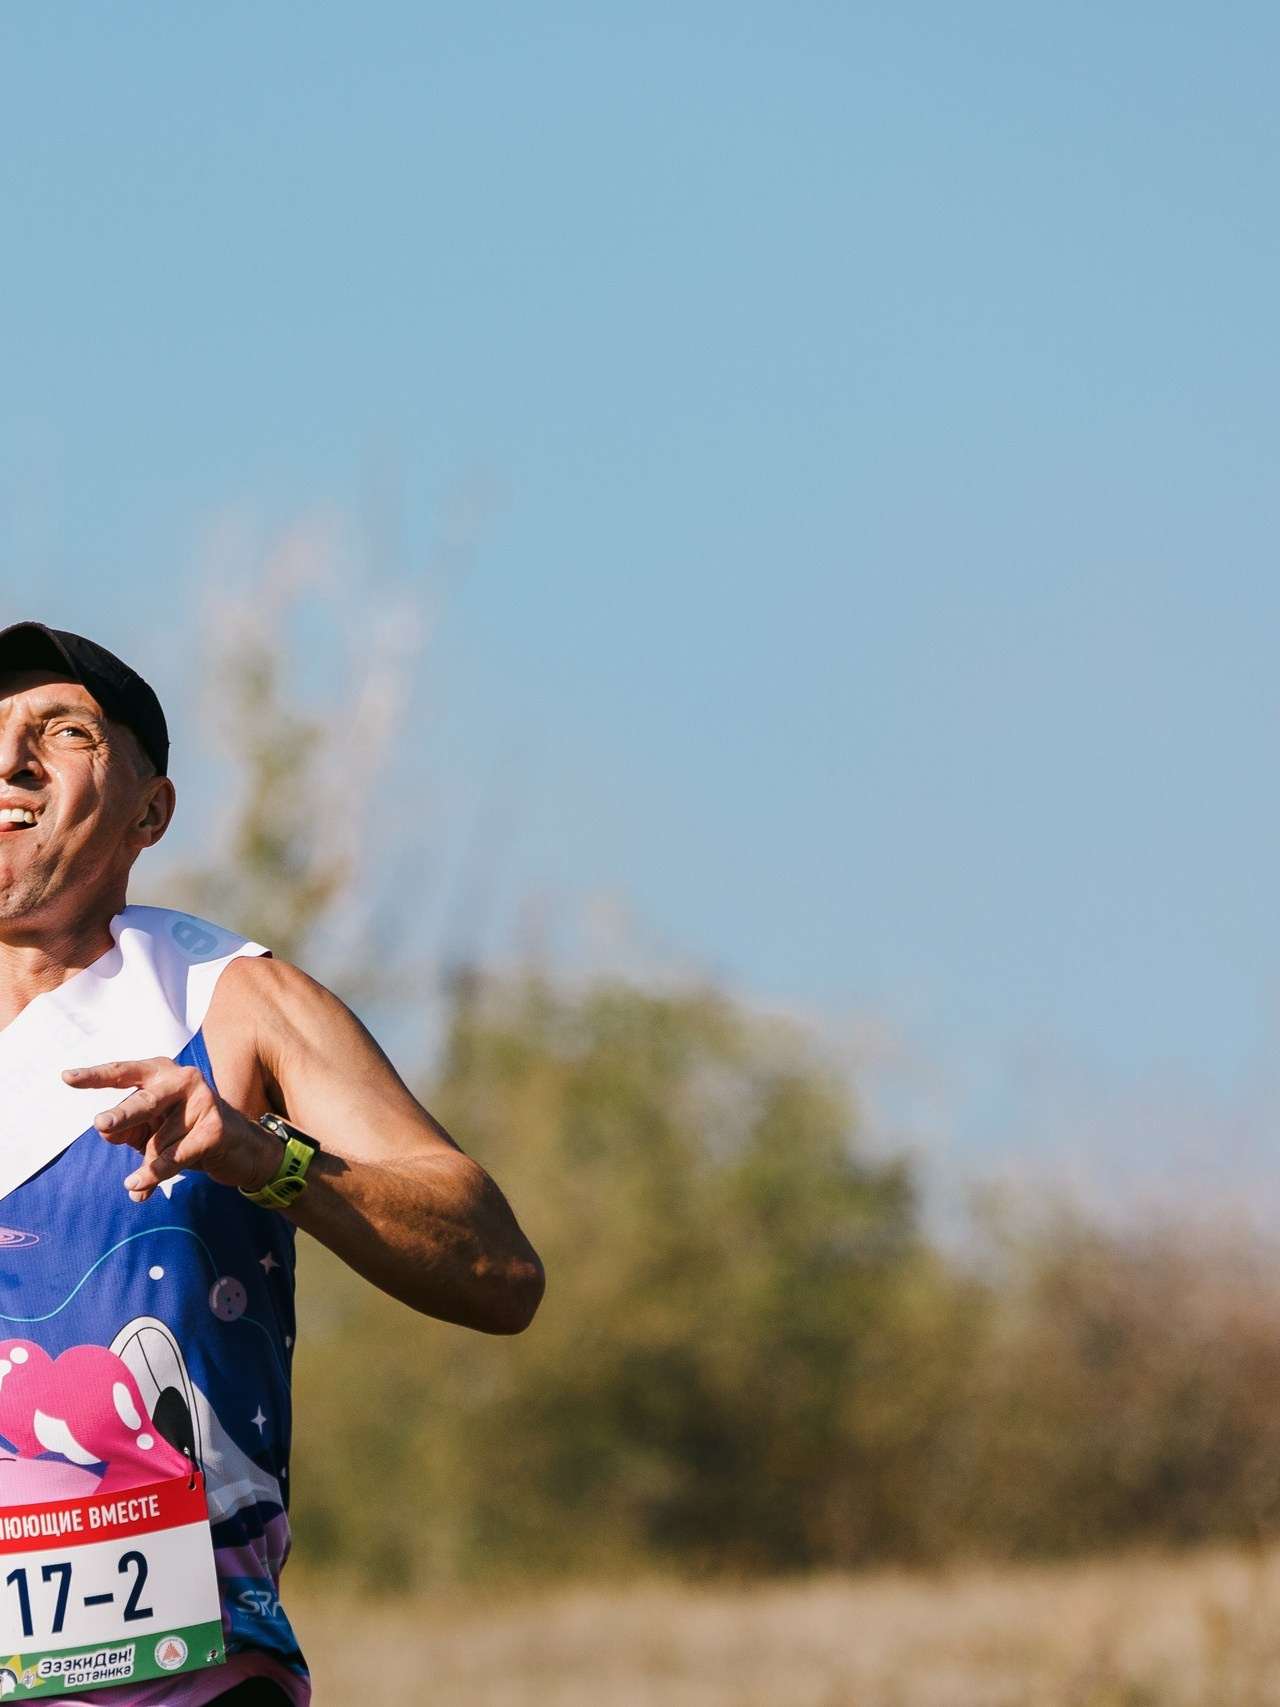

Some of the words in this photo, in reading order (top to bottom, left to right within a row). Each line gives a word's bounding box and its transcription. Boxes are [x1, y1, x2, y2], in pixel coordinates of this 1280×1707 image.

[88, 1494, 160, 1529] ВМЕСТЕ
[6, 1550, 154, 1637] 17-2
[67, 1665, 131, 1684] Ботаника
